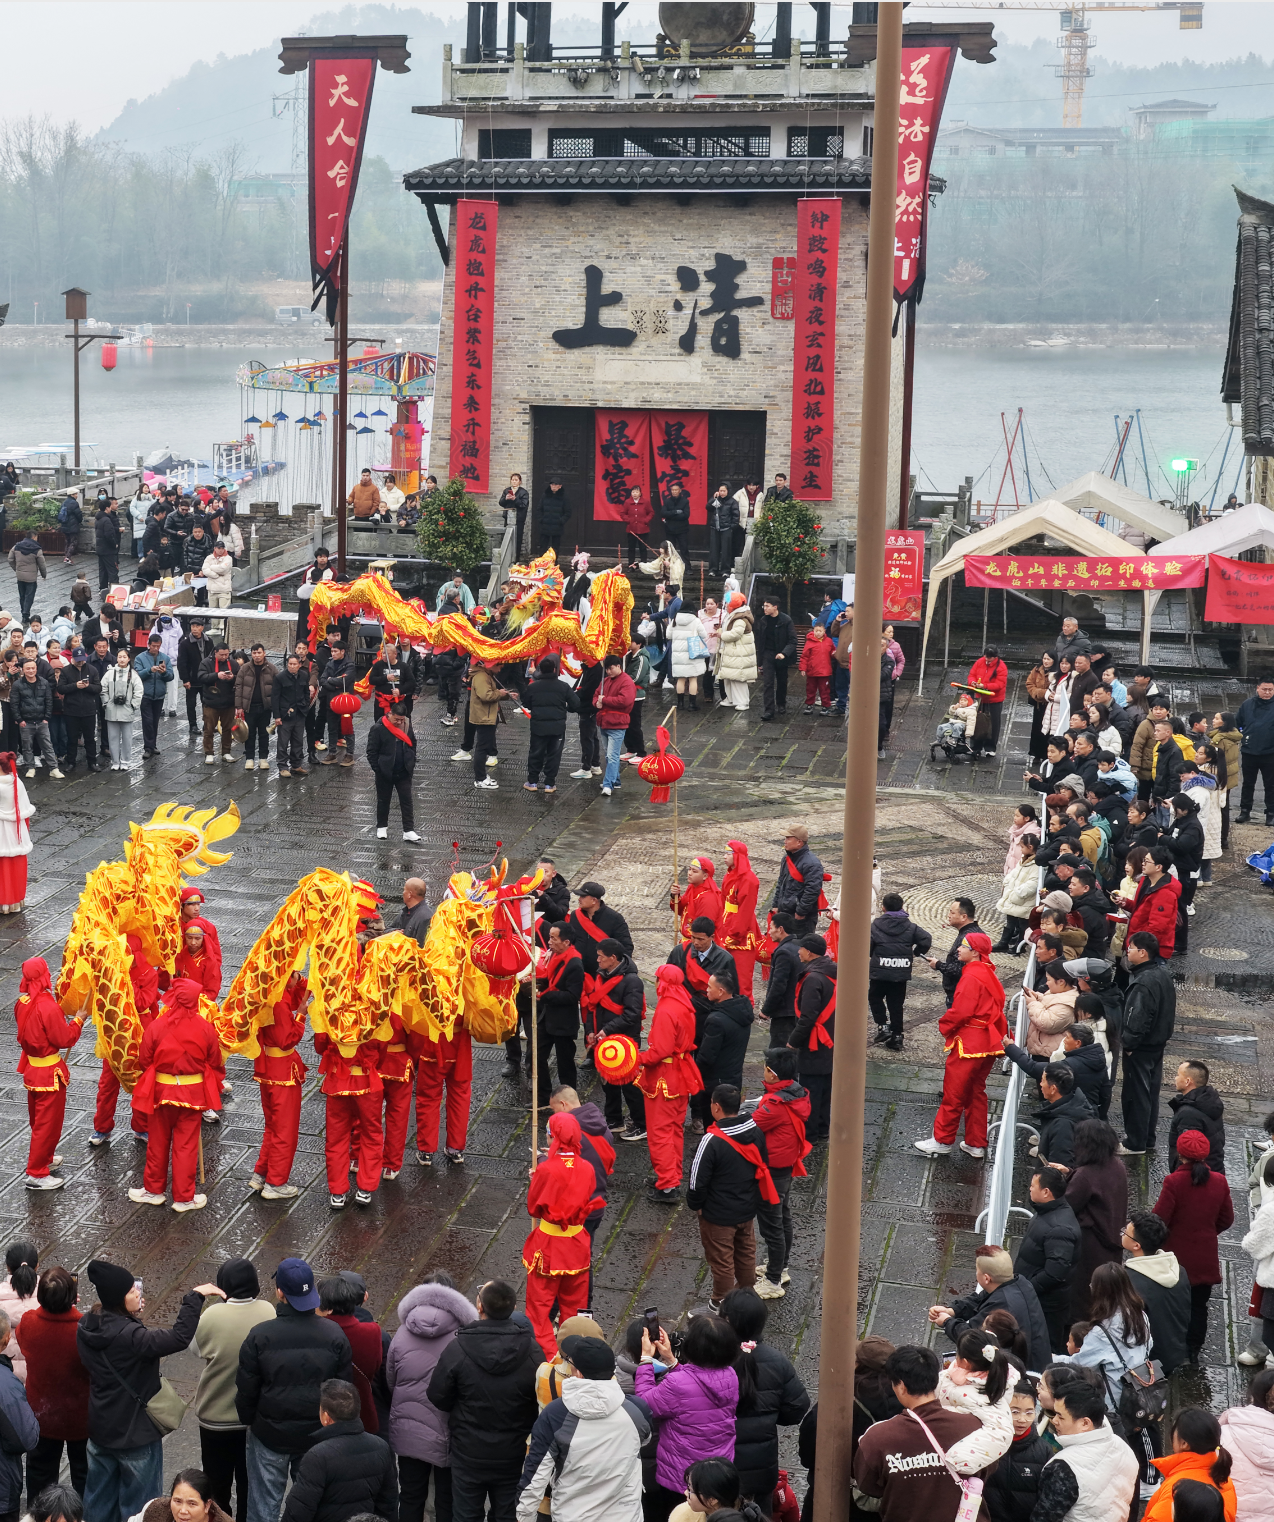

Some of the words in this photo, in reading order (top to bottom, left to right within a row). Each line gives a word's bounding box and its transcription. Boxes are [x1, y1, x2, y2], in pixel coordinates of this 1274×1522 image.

[326, 74, 359, 220] 天人合一
[552, 253, 765, 359] 上清
[984, 561, 1184, 578] 龙虎山非遗拓印体验
